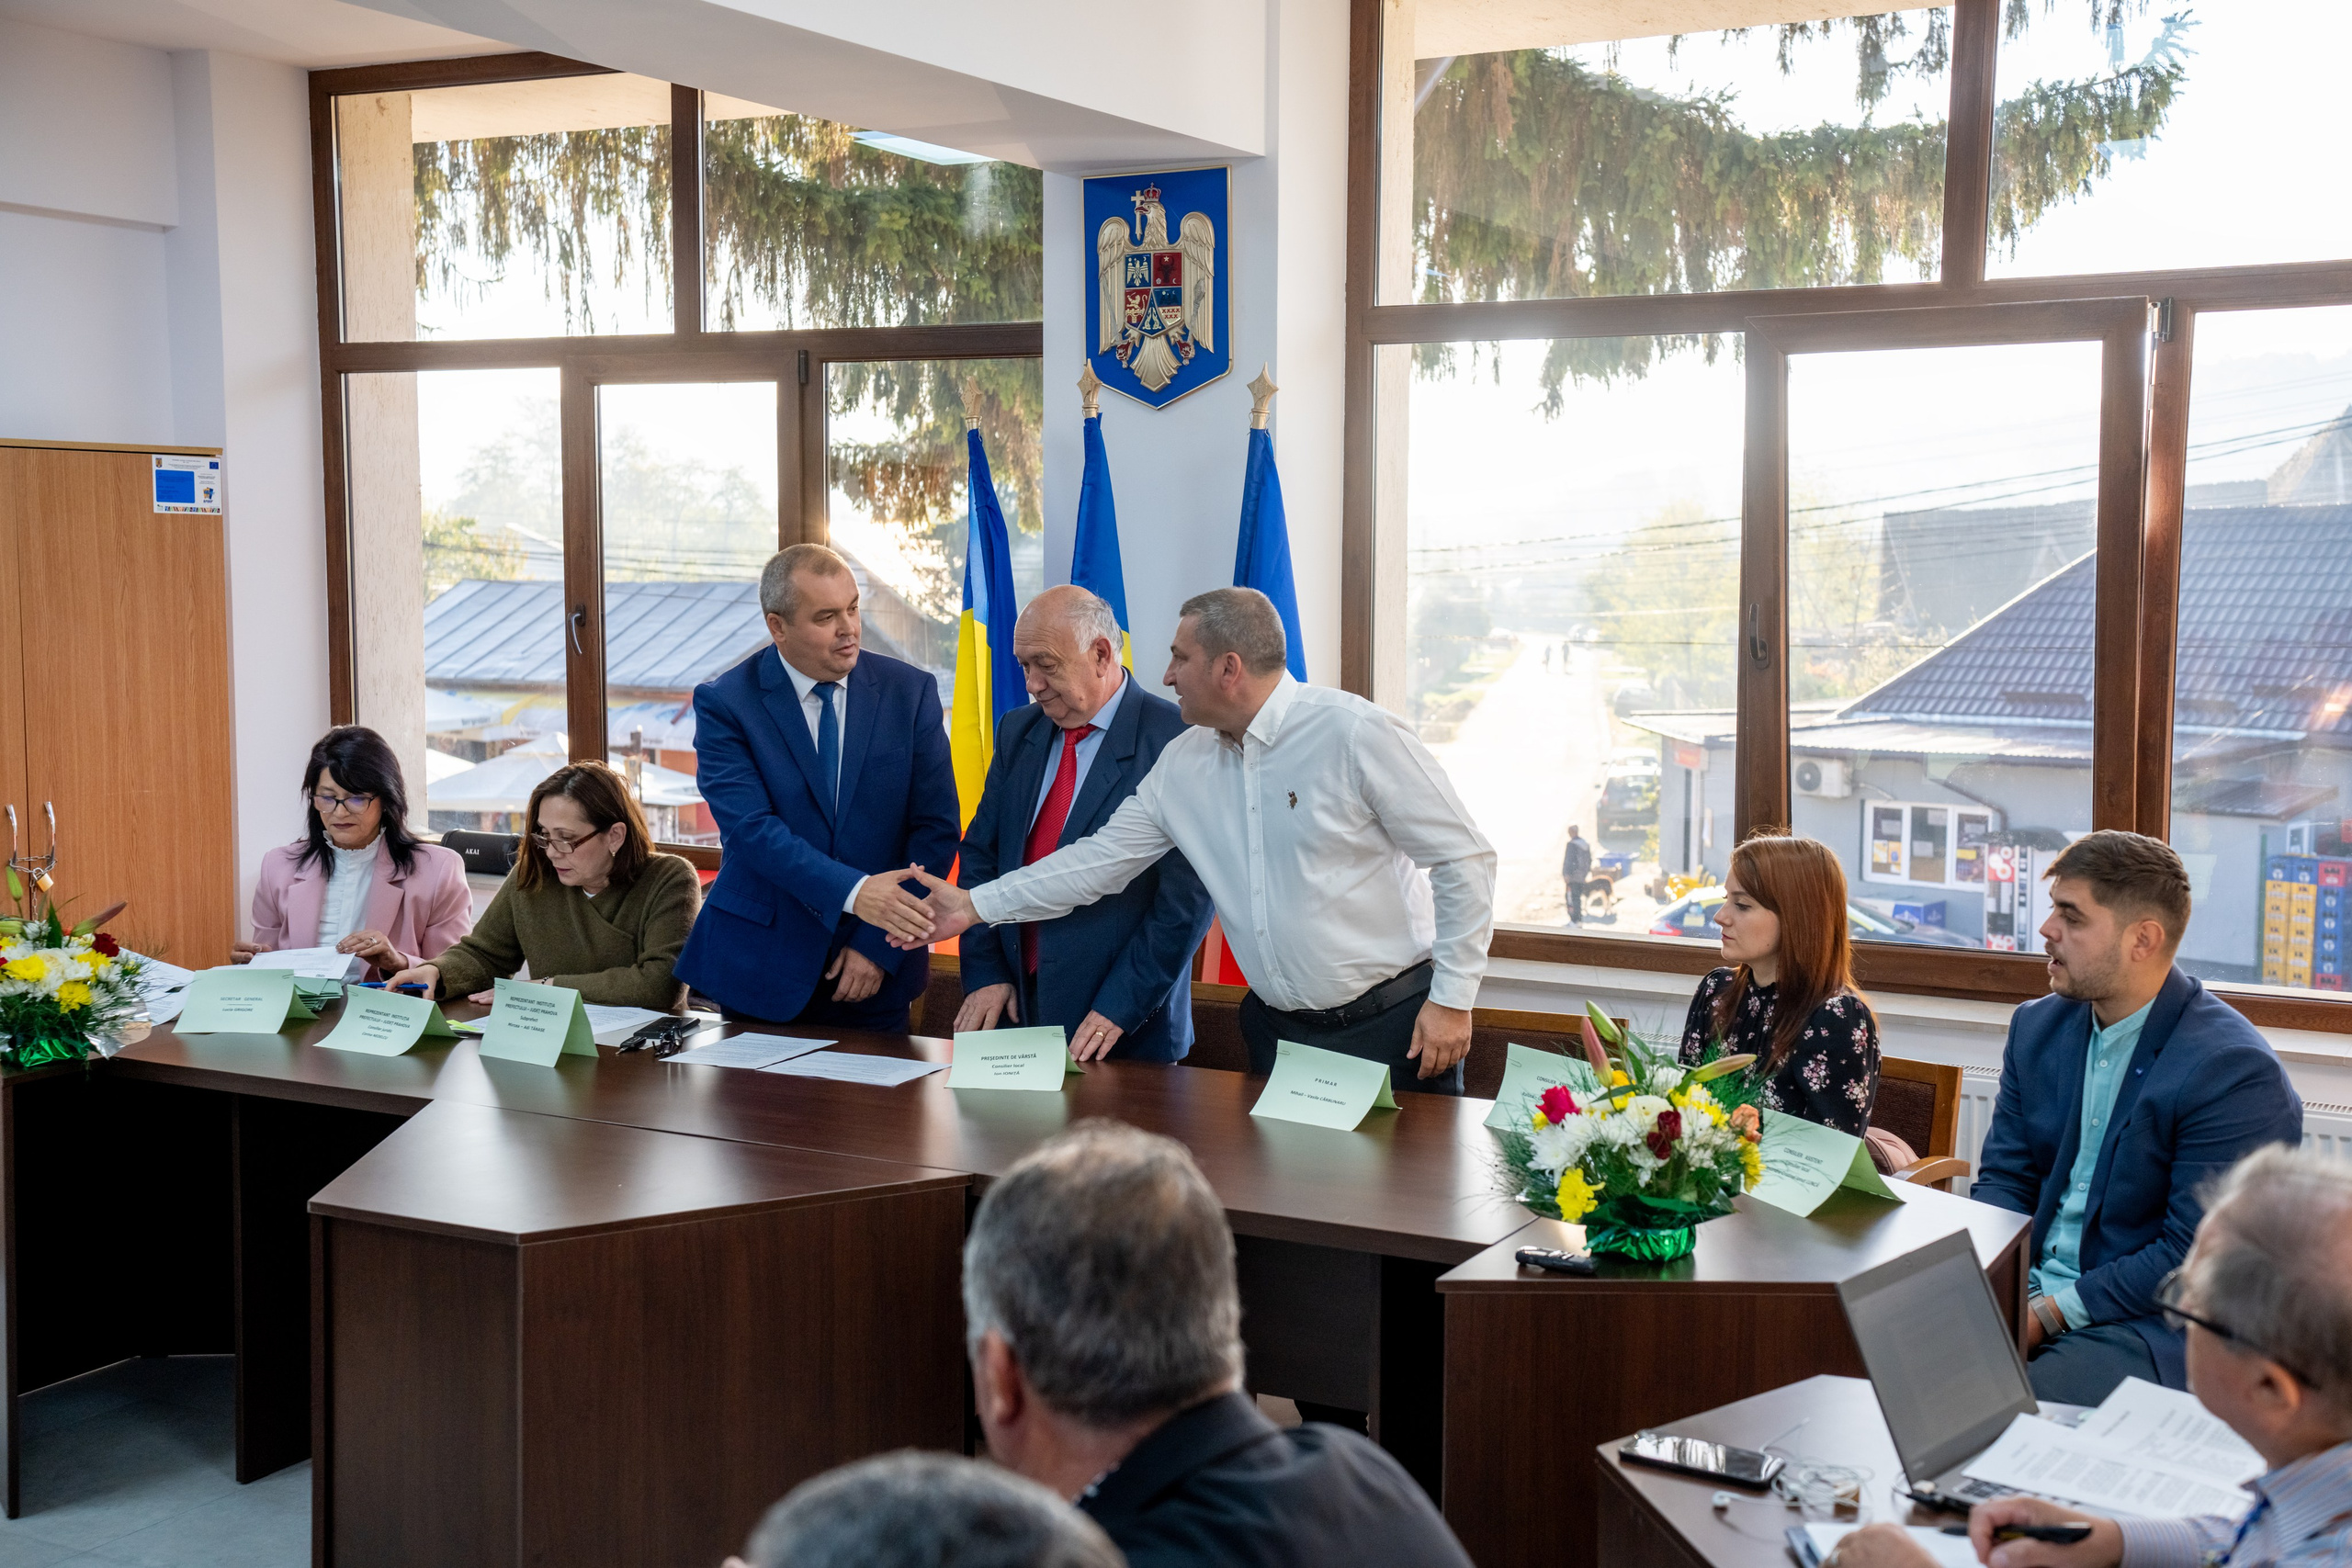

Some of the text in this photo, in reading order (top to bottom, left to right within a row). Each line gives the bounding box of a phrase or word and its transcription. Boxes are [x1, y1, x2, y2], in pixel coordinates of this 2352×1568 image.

[510, 996, 536, 1004] REPREZENTANT
[505, 1003, 527, 1011] PREFECTULUI
[365, 1008, 391, 1018] REPREZENTANT
[358, 1014, 381, 1022] PREFECTULUI
[394, 1021, 411, 1029] PRAHOVA
[1536, 1076, 1557, 1085] CONSILIER
[1783, 1146, 1824, 1165] CONSILIER ASISTENT
